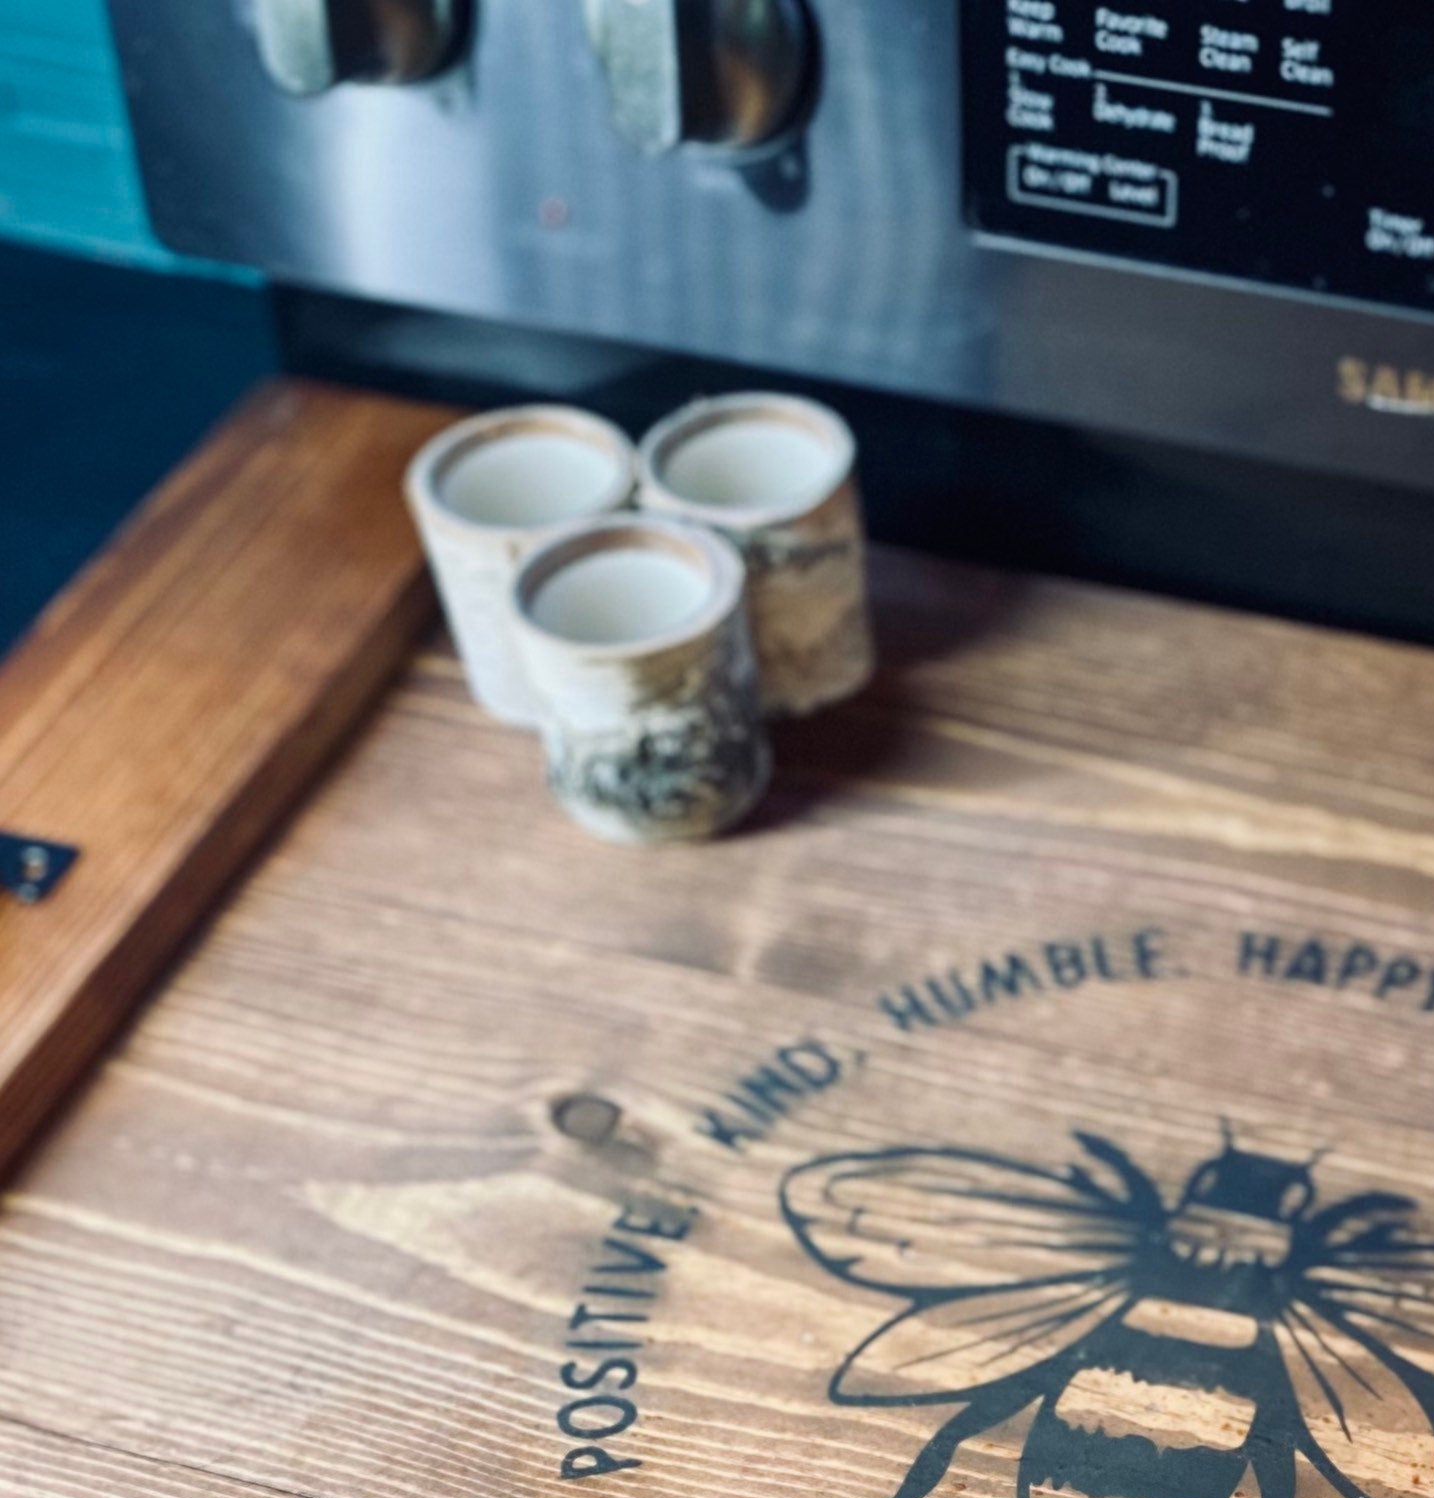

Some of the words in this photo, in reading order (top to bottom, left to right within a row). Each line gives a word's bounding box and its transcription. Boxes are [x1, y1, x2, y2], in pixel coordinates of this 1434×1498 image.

[1095, 7, 1168, 39] Favorite
[1095, 29, 1142, 55] Cook
[1200, 23, 1259, 53] Steam
[1281, 37, 1320, 61] Self
[1006, 46, 1047, 74] Easy
[1048, 53, 1091, 79] Cook
[1199, 46, 1252, 73] Clean
[1280, 59, 1334, 87] Clean
